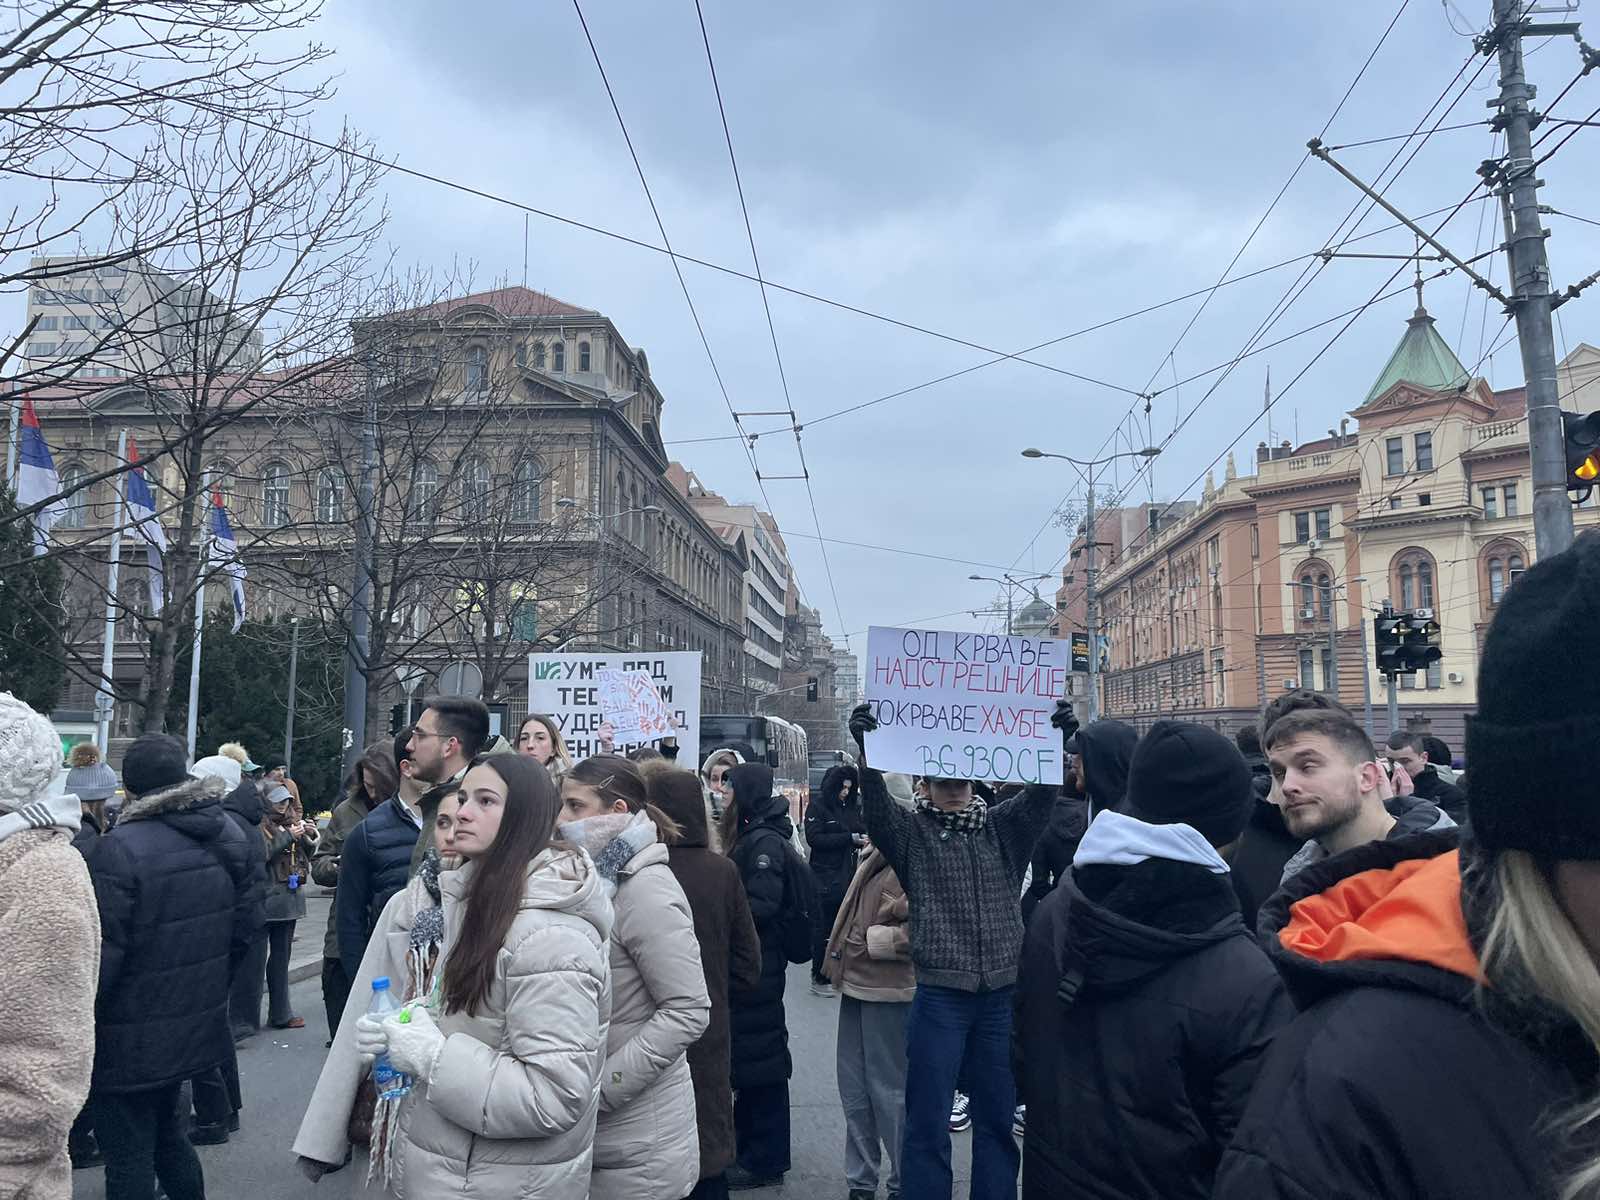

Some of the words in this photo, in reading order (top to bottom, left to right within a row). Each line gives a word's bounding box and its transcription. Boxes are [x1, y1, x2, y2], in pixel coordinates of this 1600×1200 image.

[903, 630, 940, 661] ОД
[953, 633, 1055, 668] КРВАВЕ
[874, 655, 1066, 700] НАДСТРЕШНИЦЕ
[979, 704, 1049, 739] ХАУБЕ
